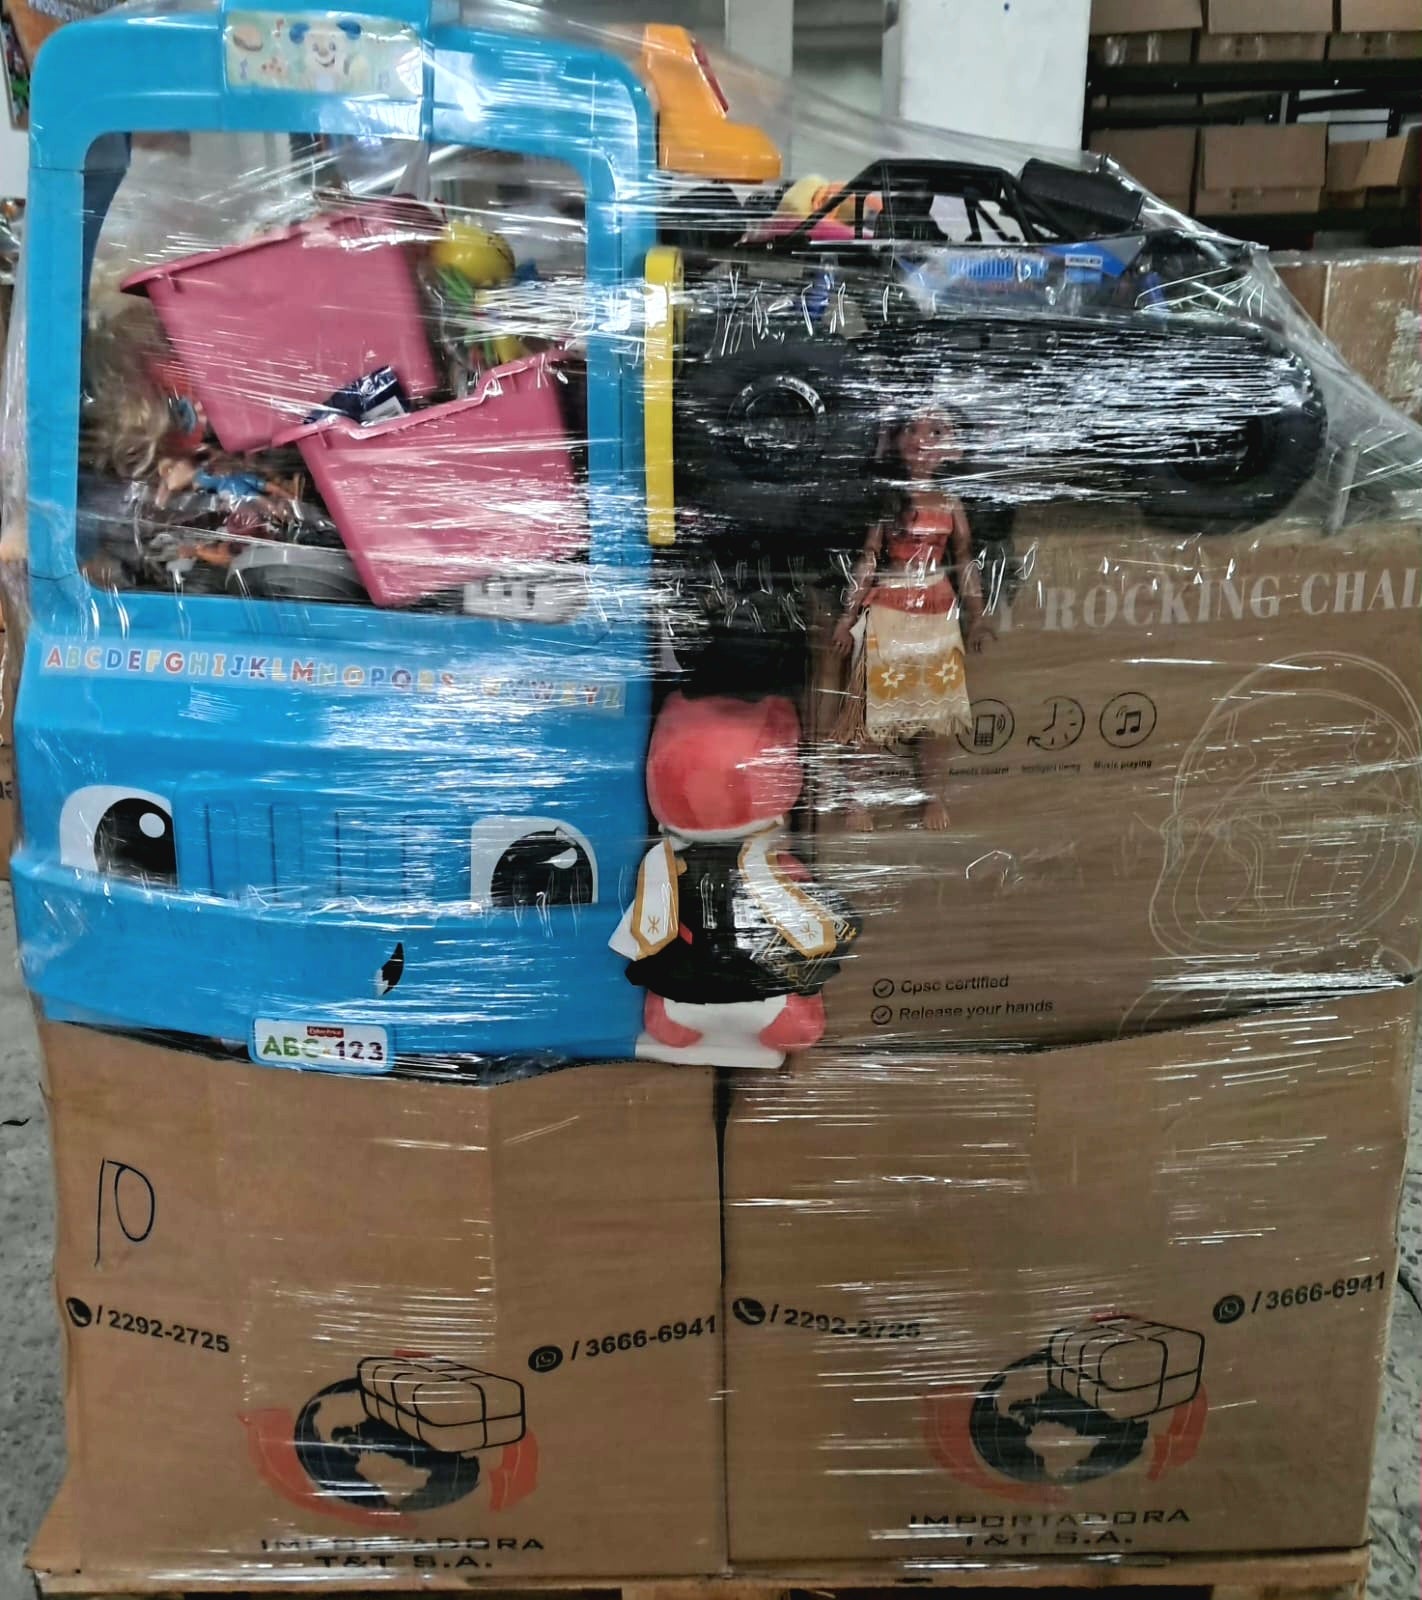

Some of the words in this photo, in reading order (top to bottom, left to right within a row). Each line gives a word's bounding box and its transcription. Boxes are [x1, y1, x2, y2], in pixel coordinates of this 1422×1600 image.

[1043, 575, 1281, 631] ROCKING
[1301, 567, 1422, 616] CHAI
[900, 979, 941, 996] Cpsc
[945, 975, 1010, 991] certified
[899, 1006, 963, 1021] Release
[966, 1004, 1002, 1020] your
[1005, 999, 1054, 1014] hands
[1265, 1271, 1386, 1310] 3666-6941
[107, 1309, 231, 1354] 2292-2725
[585, 1314, 717, 1357] 3666-6941
